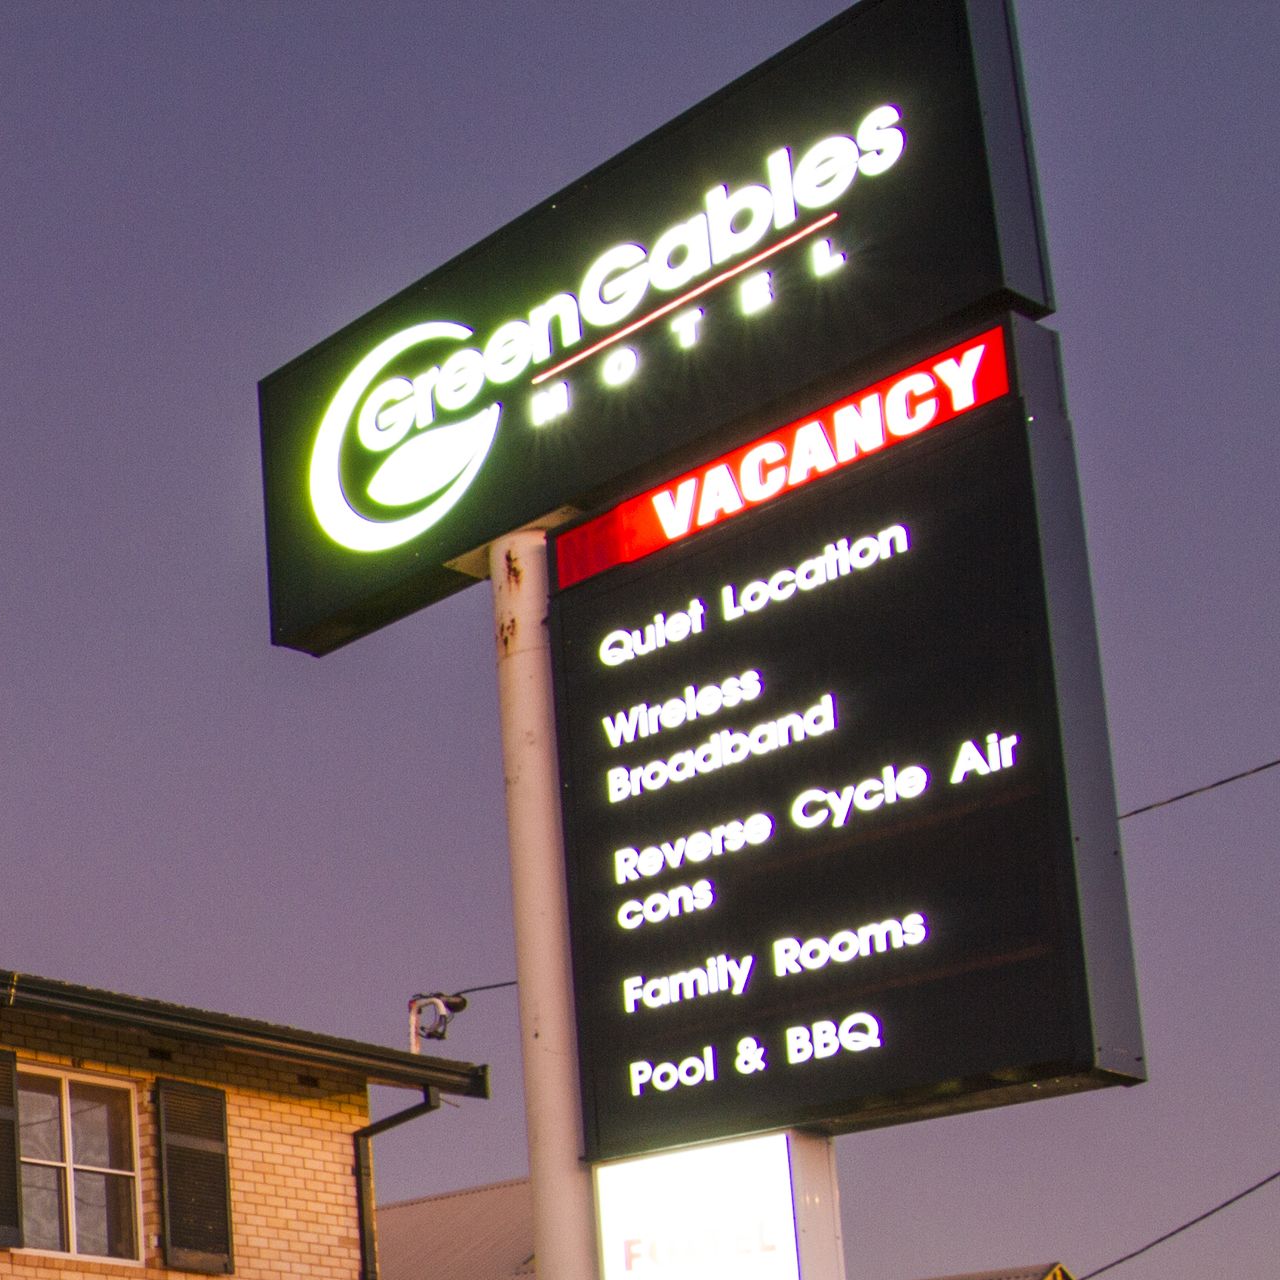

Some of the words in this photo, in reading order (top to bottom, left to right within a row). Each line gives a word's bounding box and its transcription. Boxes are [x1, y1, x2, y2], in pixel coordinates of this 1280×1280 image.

[530, 239, 845, 427] MOTEL
[652, 344, 985, 539] VACANCY
[599, 598, 704, 666] Quiet
[722, 525, 908, 621] Location
[603, 670, 762, 748] Wireless
[608, 694, 835, 803] Broadband
[615, 813, 772, 885] Reverse
[791, 765, 927, 829] Cycle
[951, 732, 1017, 784] Air
[617, 879, 713, 930] cons
[624, 954, 753, 1013] Family
[773, 913, 926, 977] Rooms
[630, 1046, 715, 1096] Pool
[735, 1036, 766, 1075] &
[786, 1012, 881, 1064] BBQ
